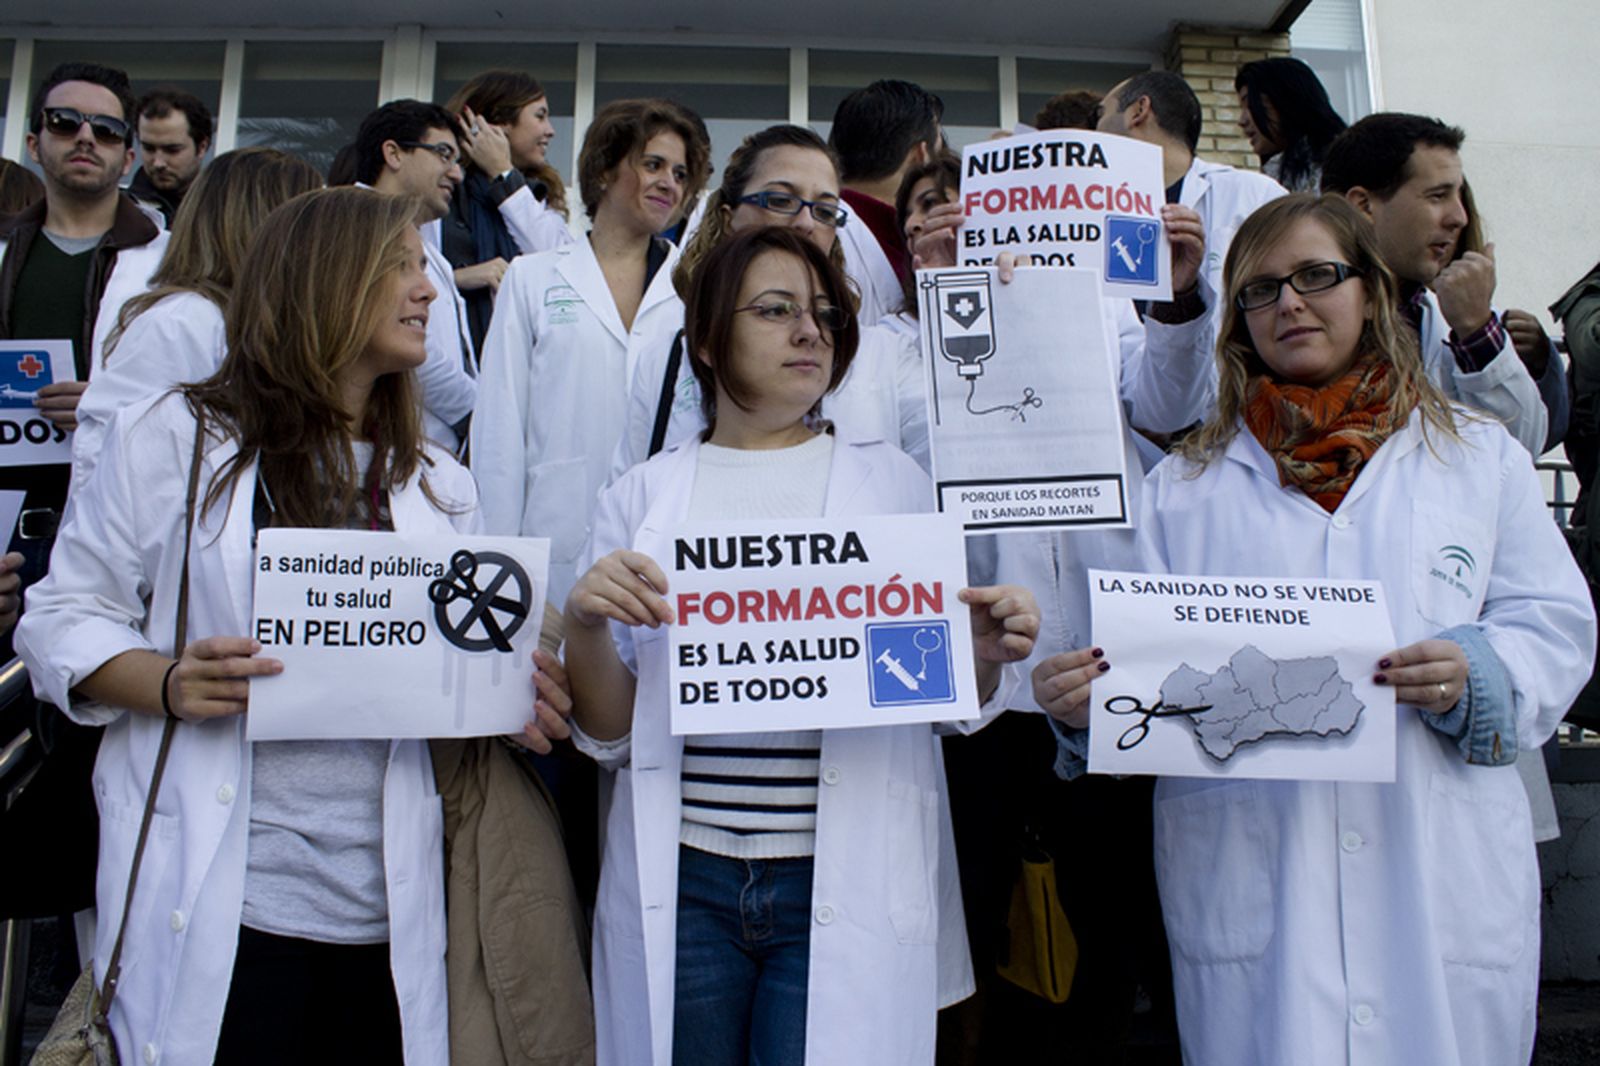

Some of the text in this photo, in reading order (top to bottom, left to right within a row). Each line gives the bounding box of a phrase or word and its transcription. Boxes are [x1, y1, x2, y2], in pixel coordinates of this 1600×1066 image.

[967, 141, 1108, 178] NUESTRA
[963, 182, 1154, 218] FORMACIÓN
[964, 223, 1101, 248] ES LA SALUD
[1030, 252, 1076, 266] DOS
[960, 485, 1101, 503] PORQUE LOS RECORTES
[971, 504, 1094, 521] EN SANIDAD MATAN
[674, 531, 869, 571] NUESTRA
[278, 553, 364, 575] sanidad
[370, 555, 445, 581] pública
[306, 587, 392, 609] tu salud
[676, 573, 944, 627] FORMACIÓN
[1099, 578, 1375, 603] LA SANIDAD NO SE VENDE
[1174, 605, 1310, 626] SE DEFIENDE
[256, 618, 426, 647] EN PELIGRO
[678, 637, 861, 667] ES LA SALUD
[679, 675, 828, 705] DE TODOS
